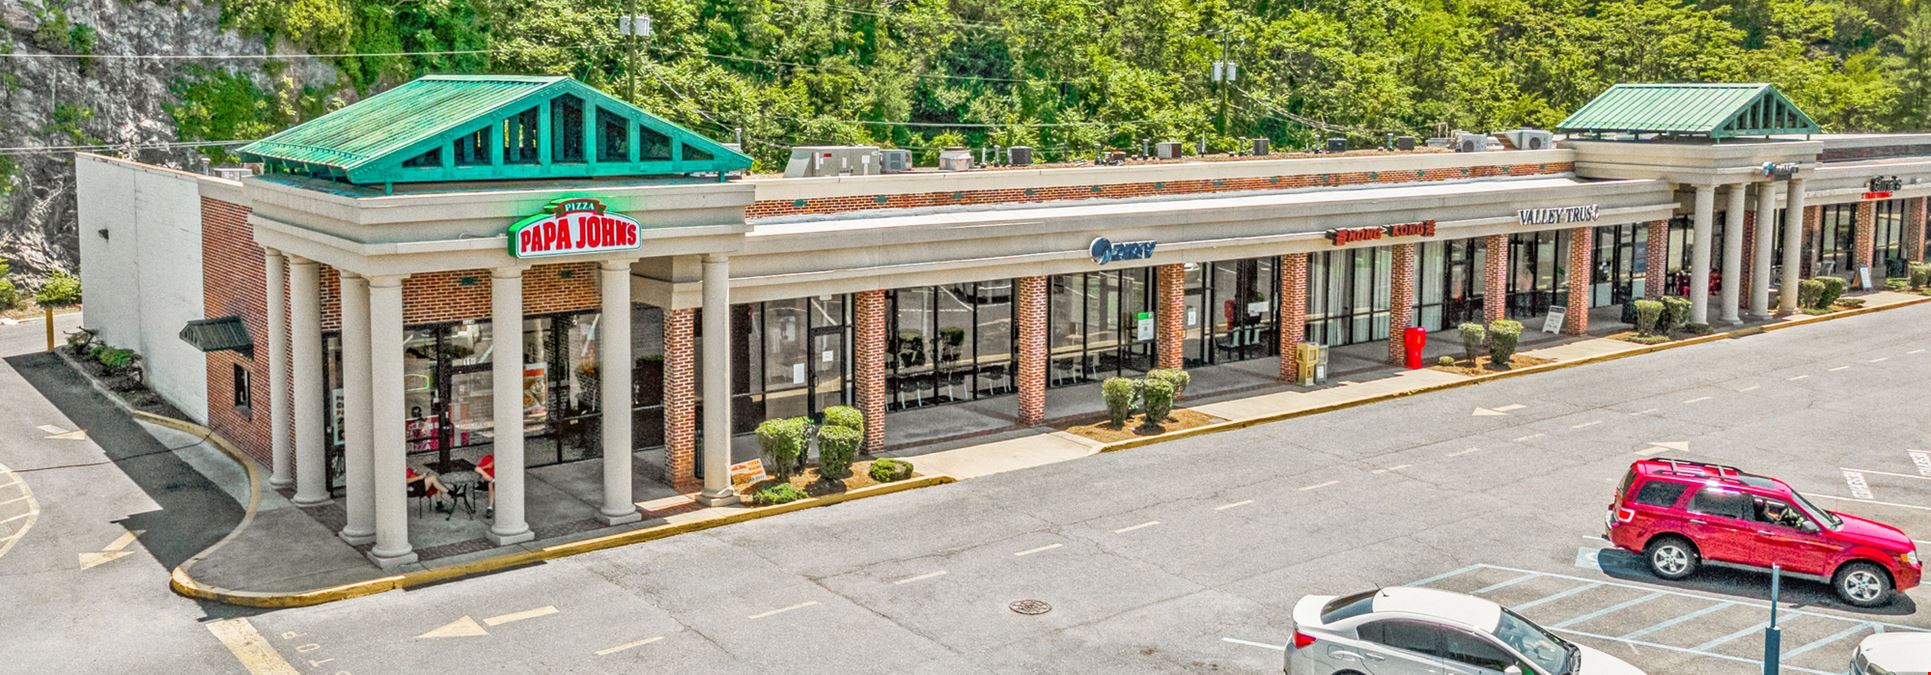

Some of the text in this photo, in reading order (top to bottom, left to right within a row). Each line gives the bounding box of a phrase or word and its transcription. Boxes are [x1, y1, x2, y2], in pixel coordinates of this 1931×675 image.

[564, 202, 595, 212] PIZZA
[1519, 208, 1563, 225] VALLEY
[520, 216, 637, 253] PAPA JOHN'S
